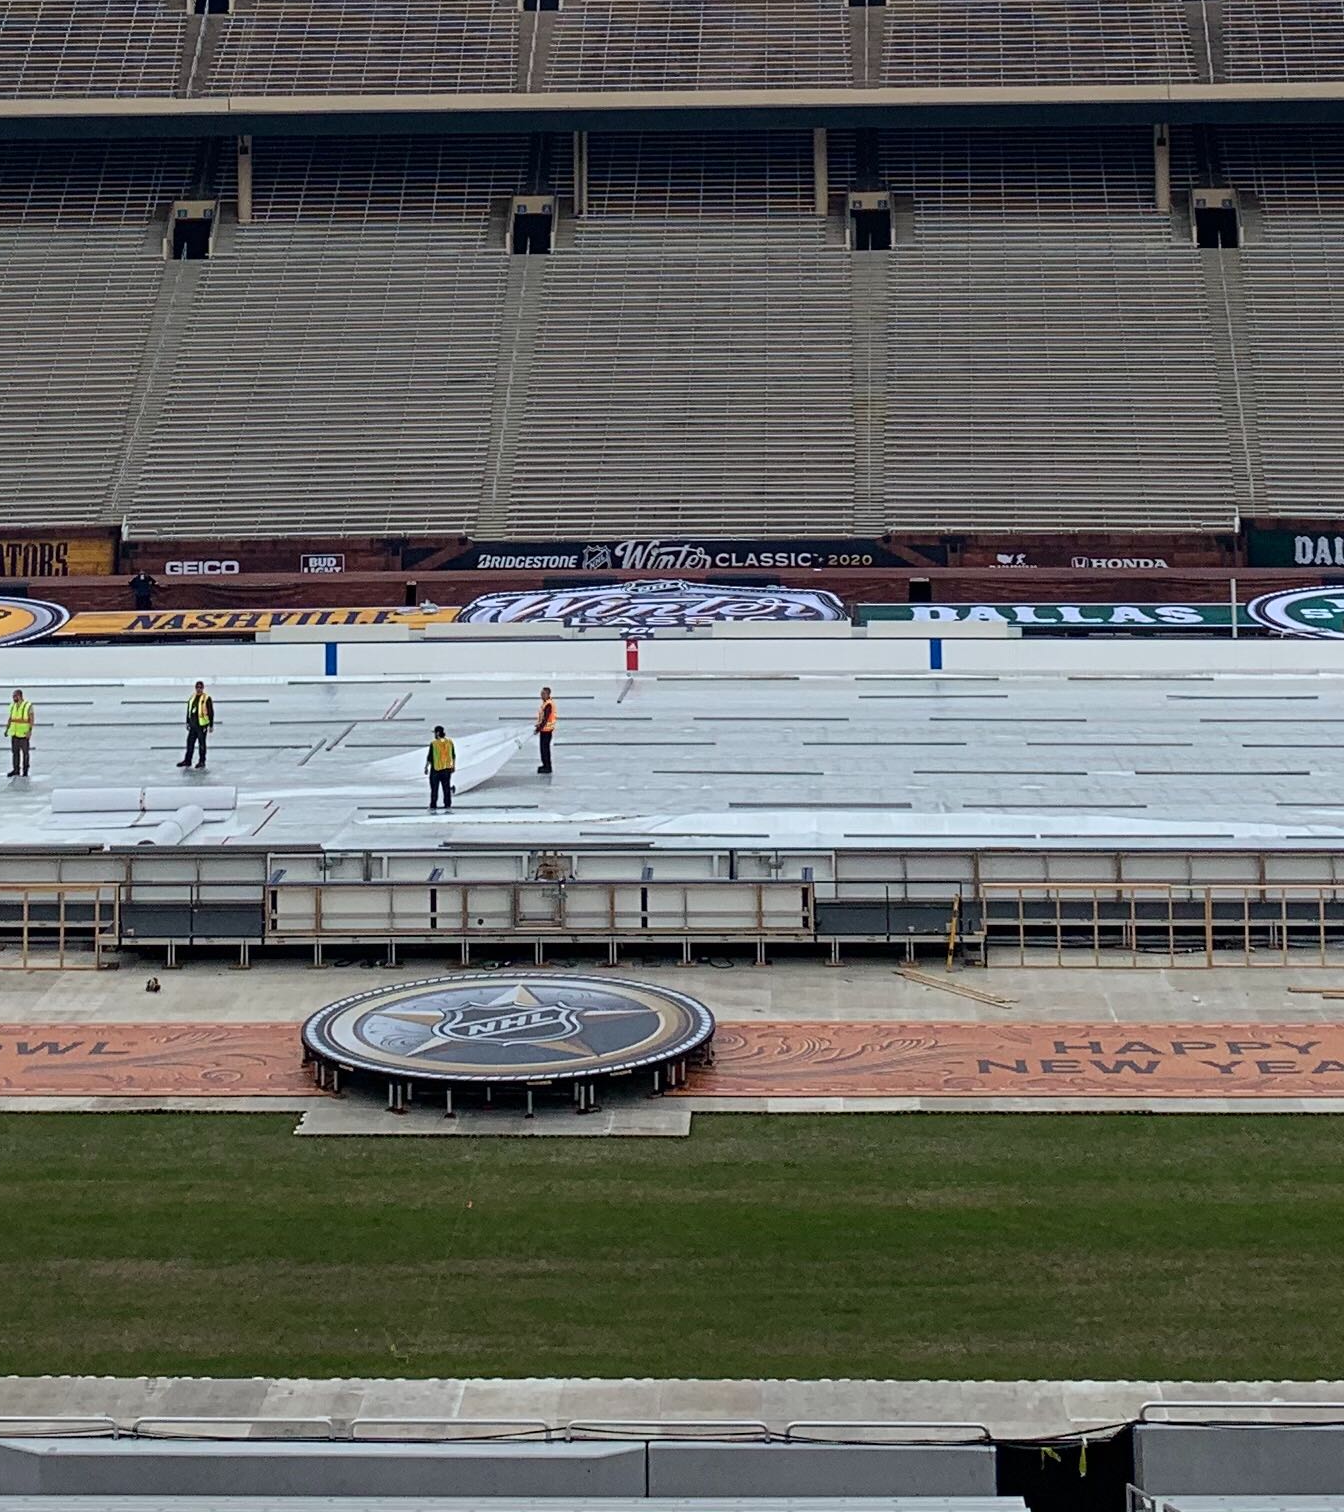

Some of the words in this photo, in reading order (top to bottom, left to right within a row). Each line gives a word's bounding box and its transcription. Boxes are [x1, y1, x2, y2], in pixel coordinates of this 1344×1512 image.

[308, 557, 337, 567] BUD
[477, 554, 579, 569] BRIDGESTONE
[614, 539, 712, 569] Winter
[716, 552, 813, 568] CLASSIC
[828, 553, 873, 567] 2020
[165, 560, 240, 575] GEICO
[1091, 559, 1168, 569] HONDA
[476, 590, 817, 621] Winter
[909, 606, 1205, 624] DALLAS
[467, 1010, 558, 1037] NHL
[1052, 1040, 1323, 1055] HAPPY
[975, 1059, 1163, 1075] NEW
